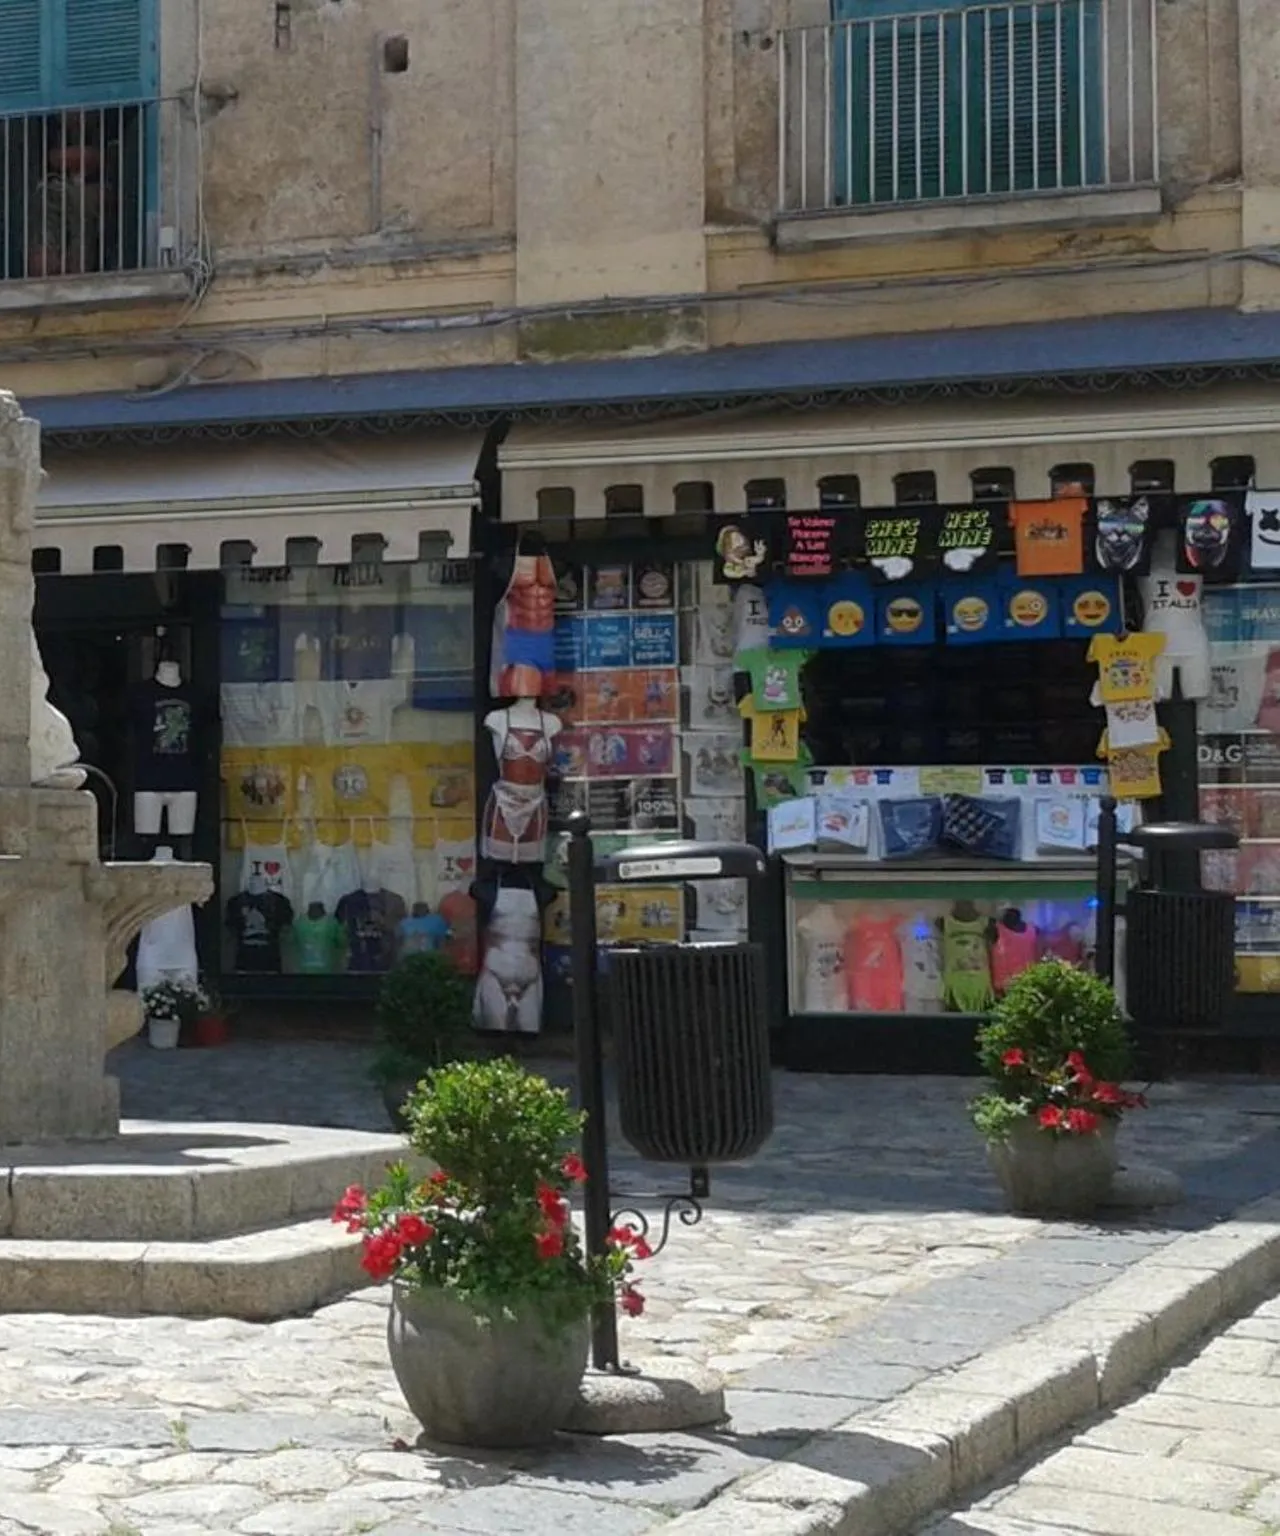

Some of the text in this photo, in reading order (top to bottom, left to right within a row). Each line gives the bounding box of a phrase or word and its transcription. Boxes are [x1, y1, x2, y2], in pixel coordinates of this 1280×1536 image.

[865, 519, 920, 538] SHE'S
[945, 510, 990, 529] HE'S
[866, 537, 917, 556] MINE
[938, 528, 993, 547] MINE
[1197, 745, 1242, 762] D&G
